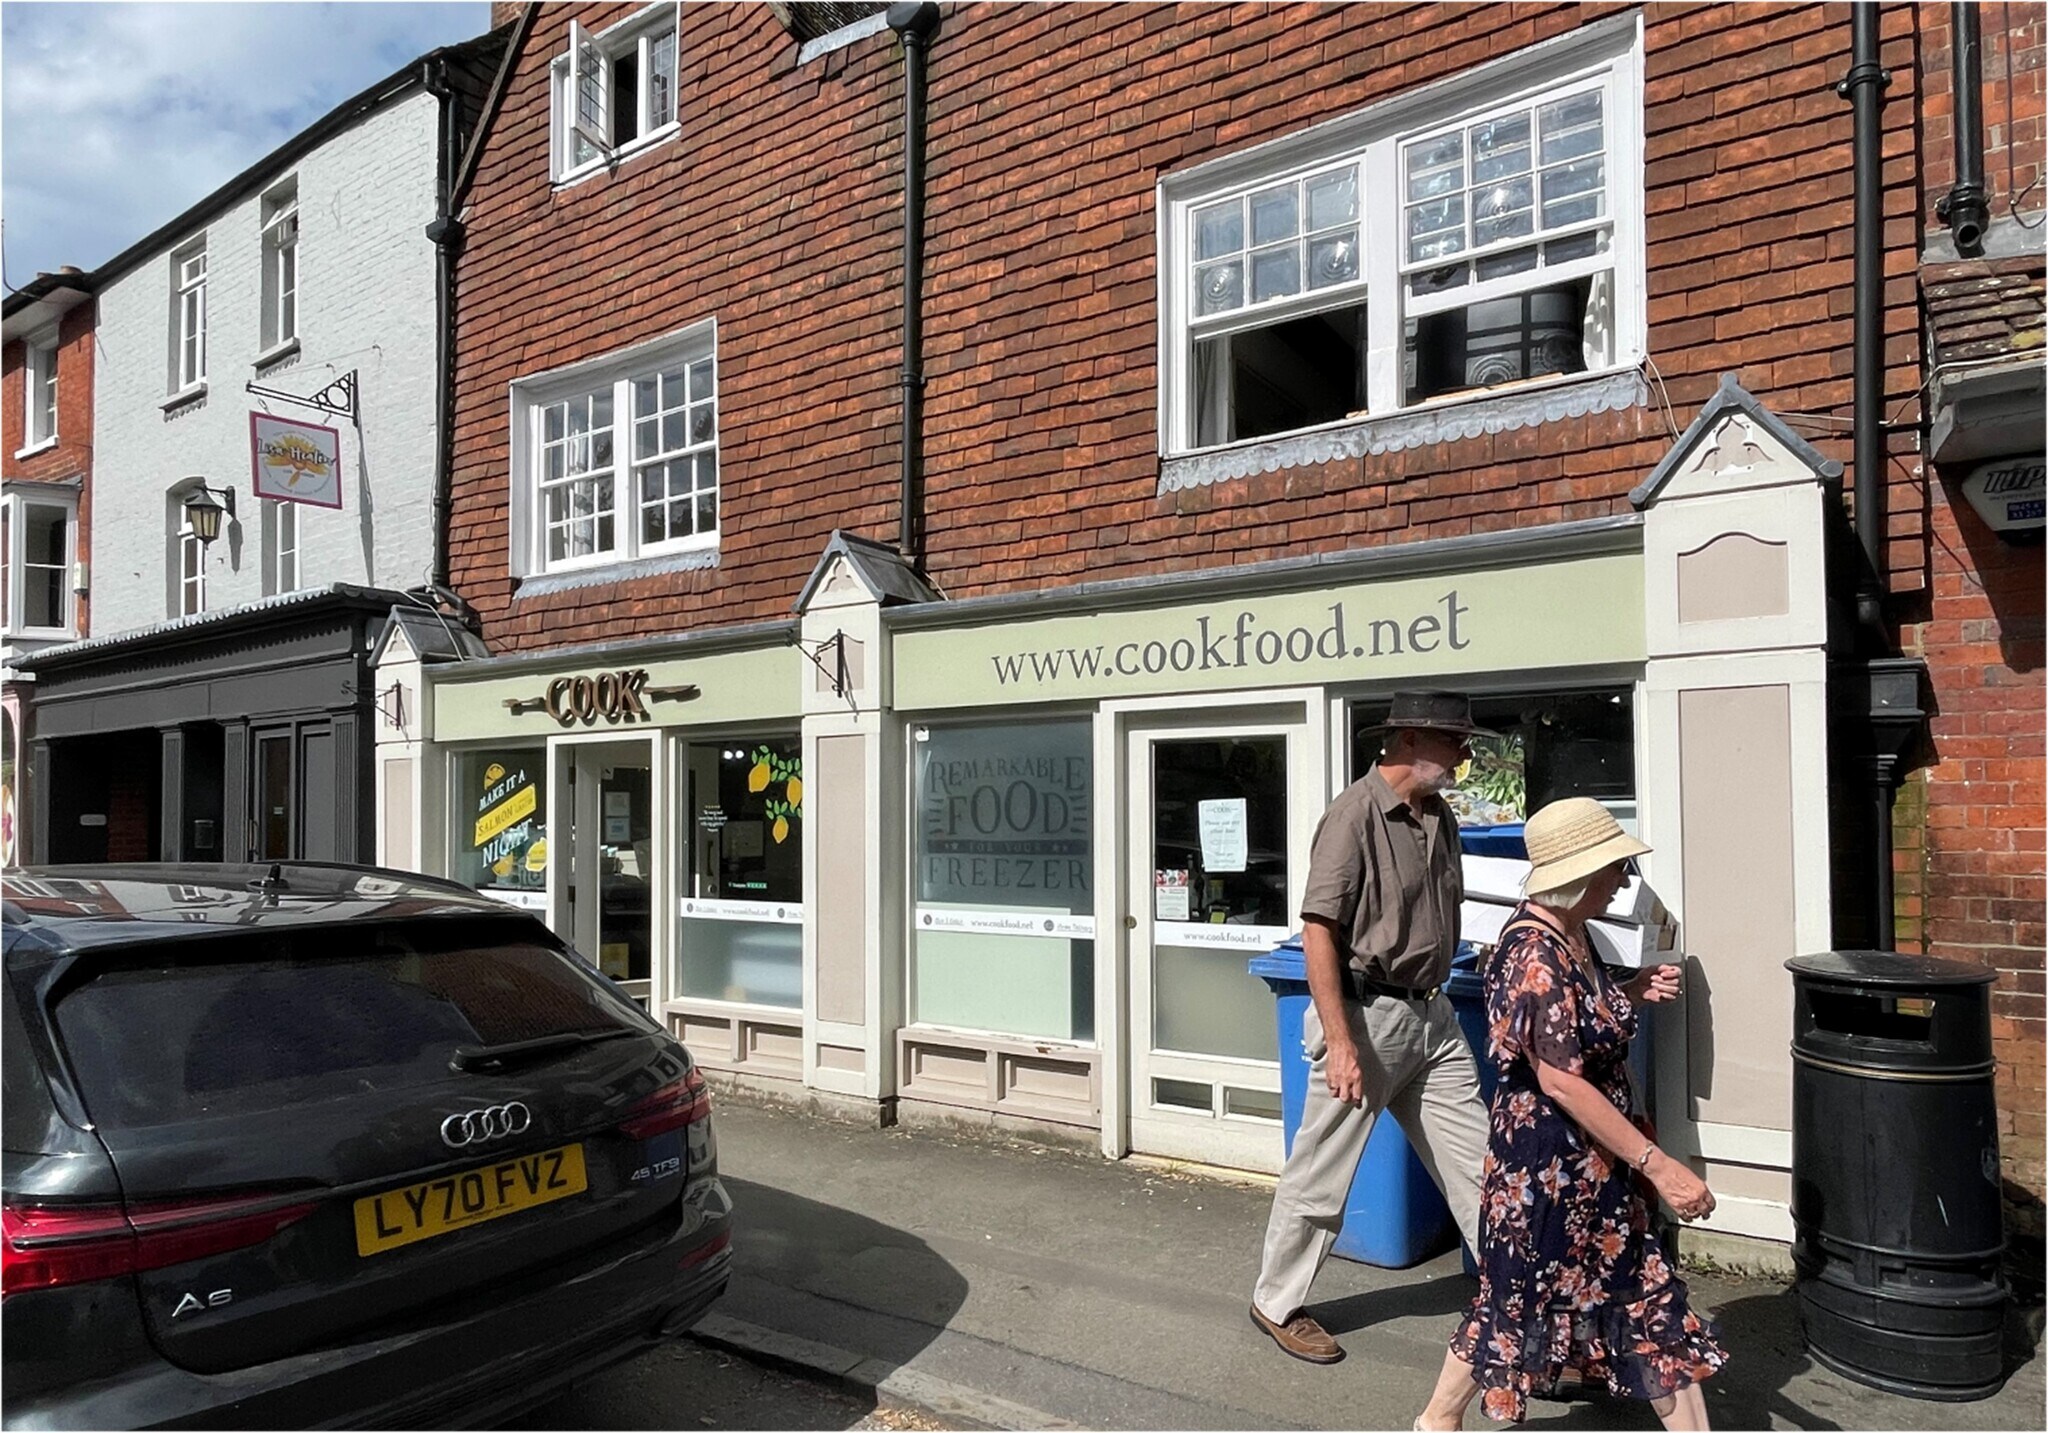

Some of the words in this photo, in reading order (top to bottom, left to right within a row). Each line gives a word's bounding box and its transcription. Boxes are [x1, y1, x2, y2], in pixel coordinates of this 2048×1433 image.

[991, 590, 1470, 685] www.cookfood.net
[546, 668, 650, 724] COOK
[479, 783, 505, 812] MAKE
[506, 774, 517, 793] IT
[518, 769, 526, 784] A
[930, 756, 1086, 794] REMARKABLE
[478, 804, 514, 837] SALMON
[946, 779, 1069, 836] FOOD
[928, 856, 1089, 891] FREEZER
[970, 919, 1034, 930] www.cookfood.net
[1184, 931, 1261, 944] www.cookfood.net
[630, 1166, 651, 1181] 45
[376, 1173, 486, 1239] LY70
[494, 1151, 568, 1204] FVZ
[171, 1288, 233, 1318] A6
